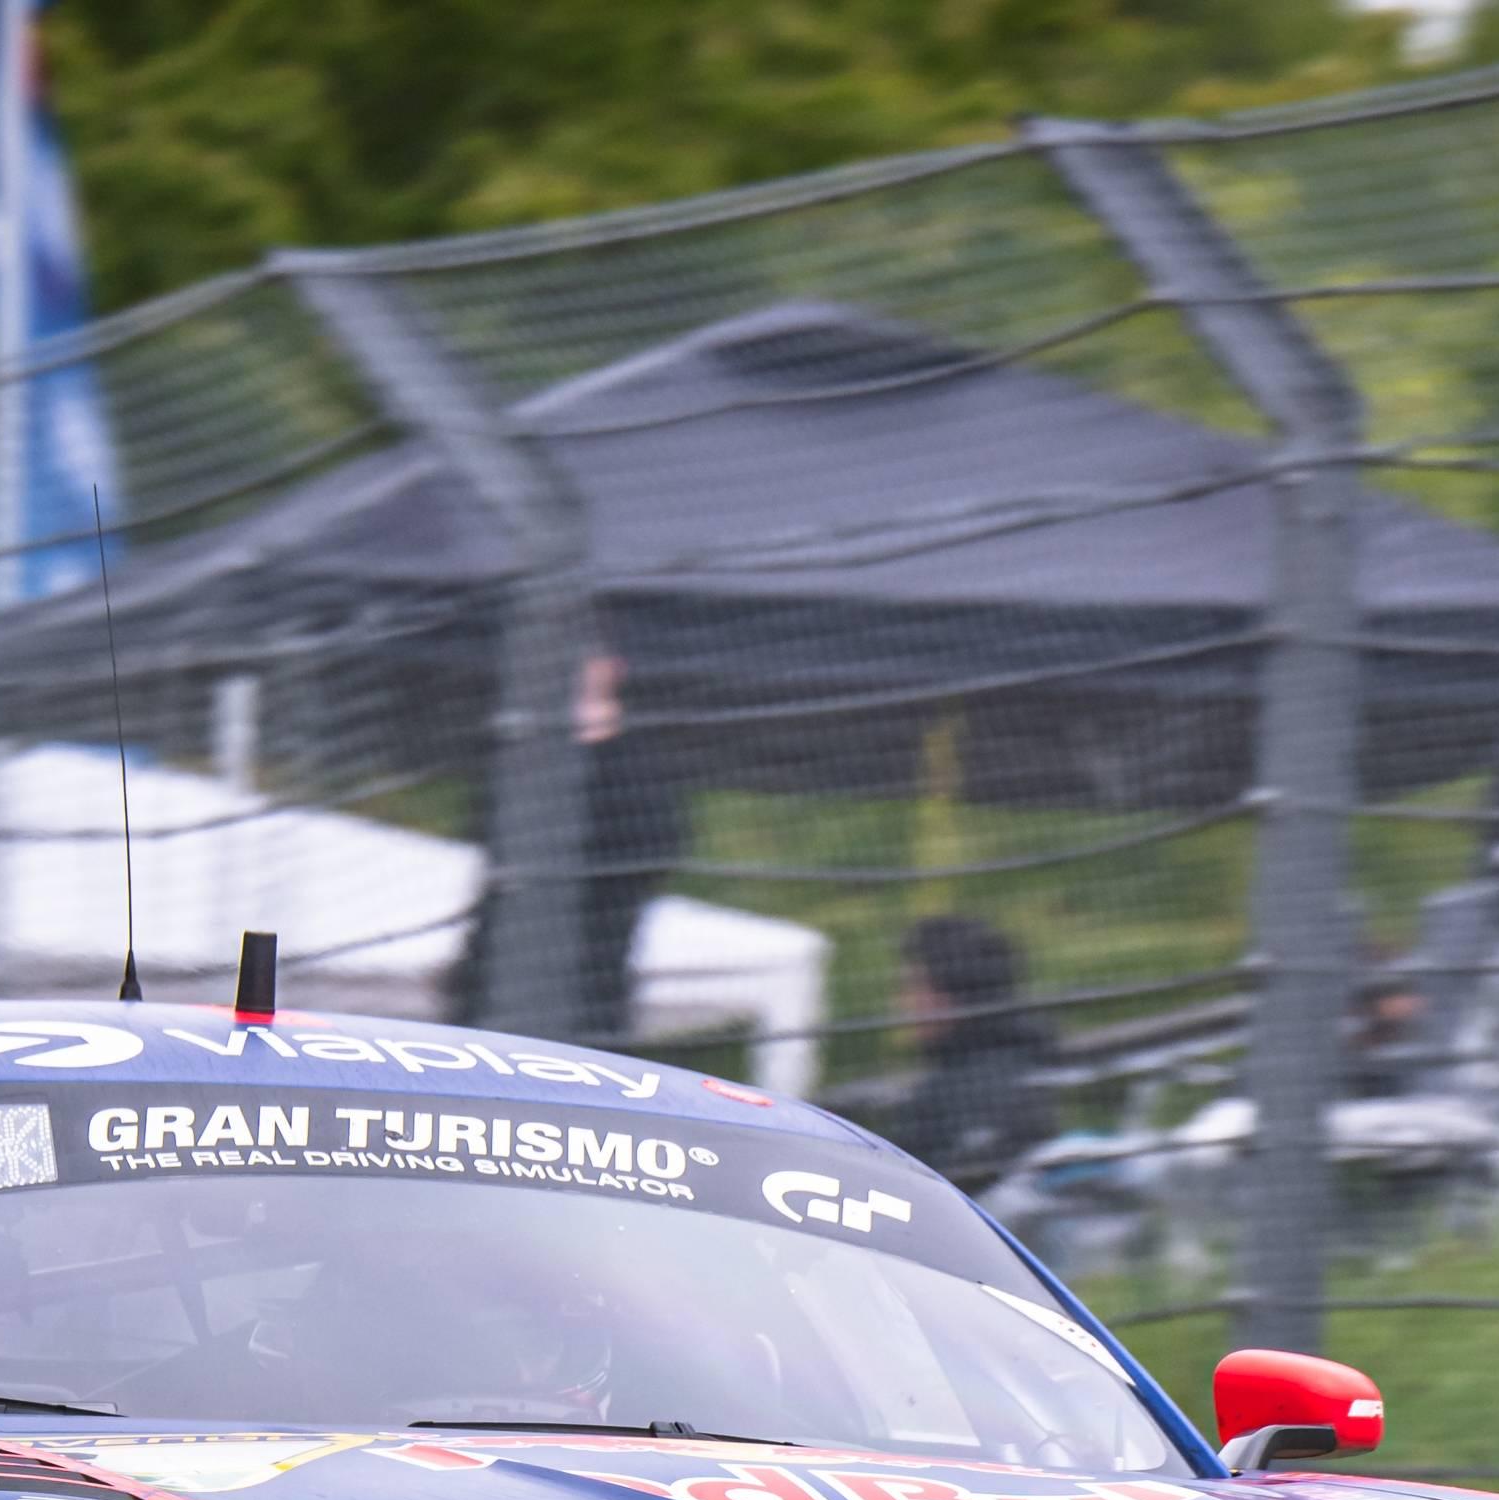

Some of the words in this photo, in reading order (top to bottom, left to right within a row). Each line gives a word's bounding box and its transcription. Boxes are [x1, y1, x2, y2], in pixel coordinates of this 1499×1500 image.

[162, 1027, 660, 1098] viaplay
[87, 1105, 309, 1152] GRAN
[101, 1150, 183, 1170] THE
[192, 1150, 297, 1168] REAL
[303, 1151, 465, 1172] DRIVING
[473, 1159, 695, 1200] SIMULATOR
